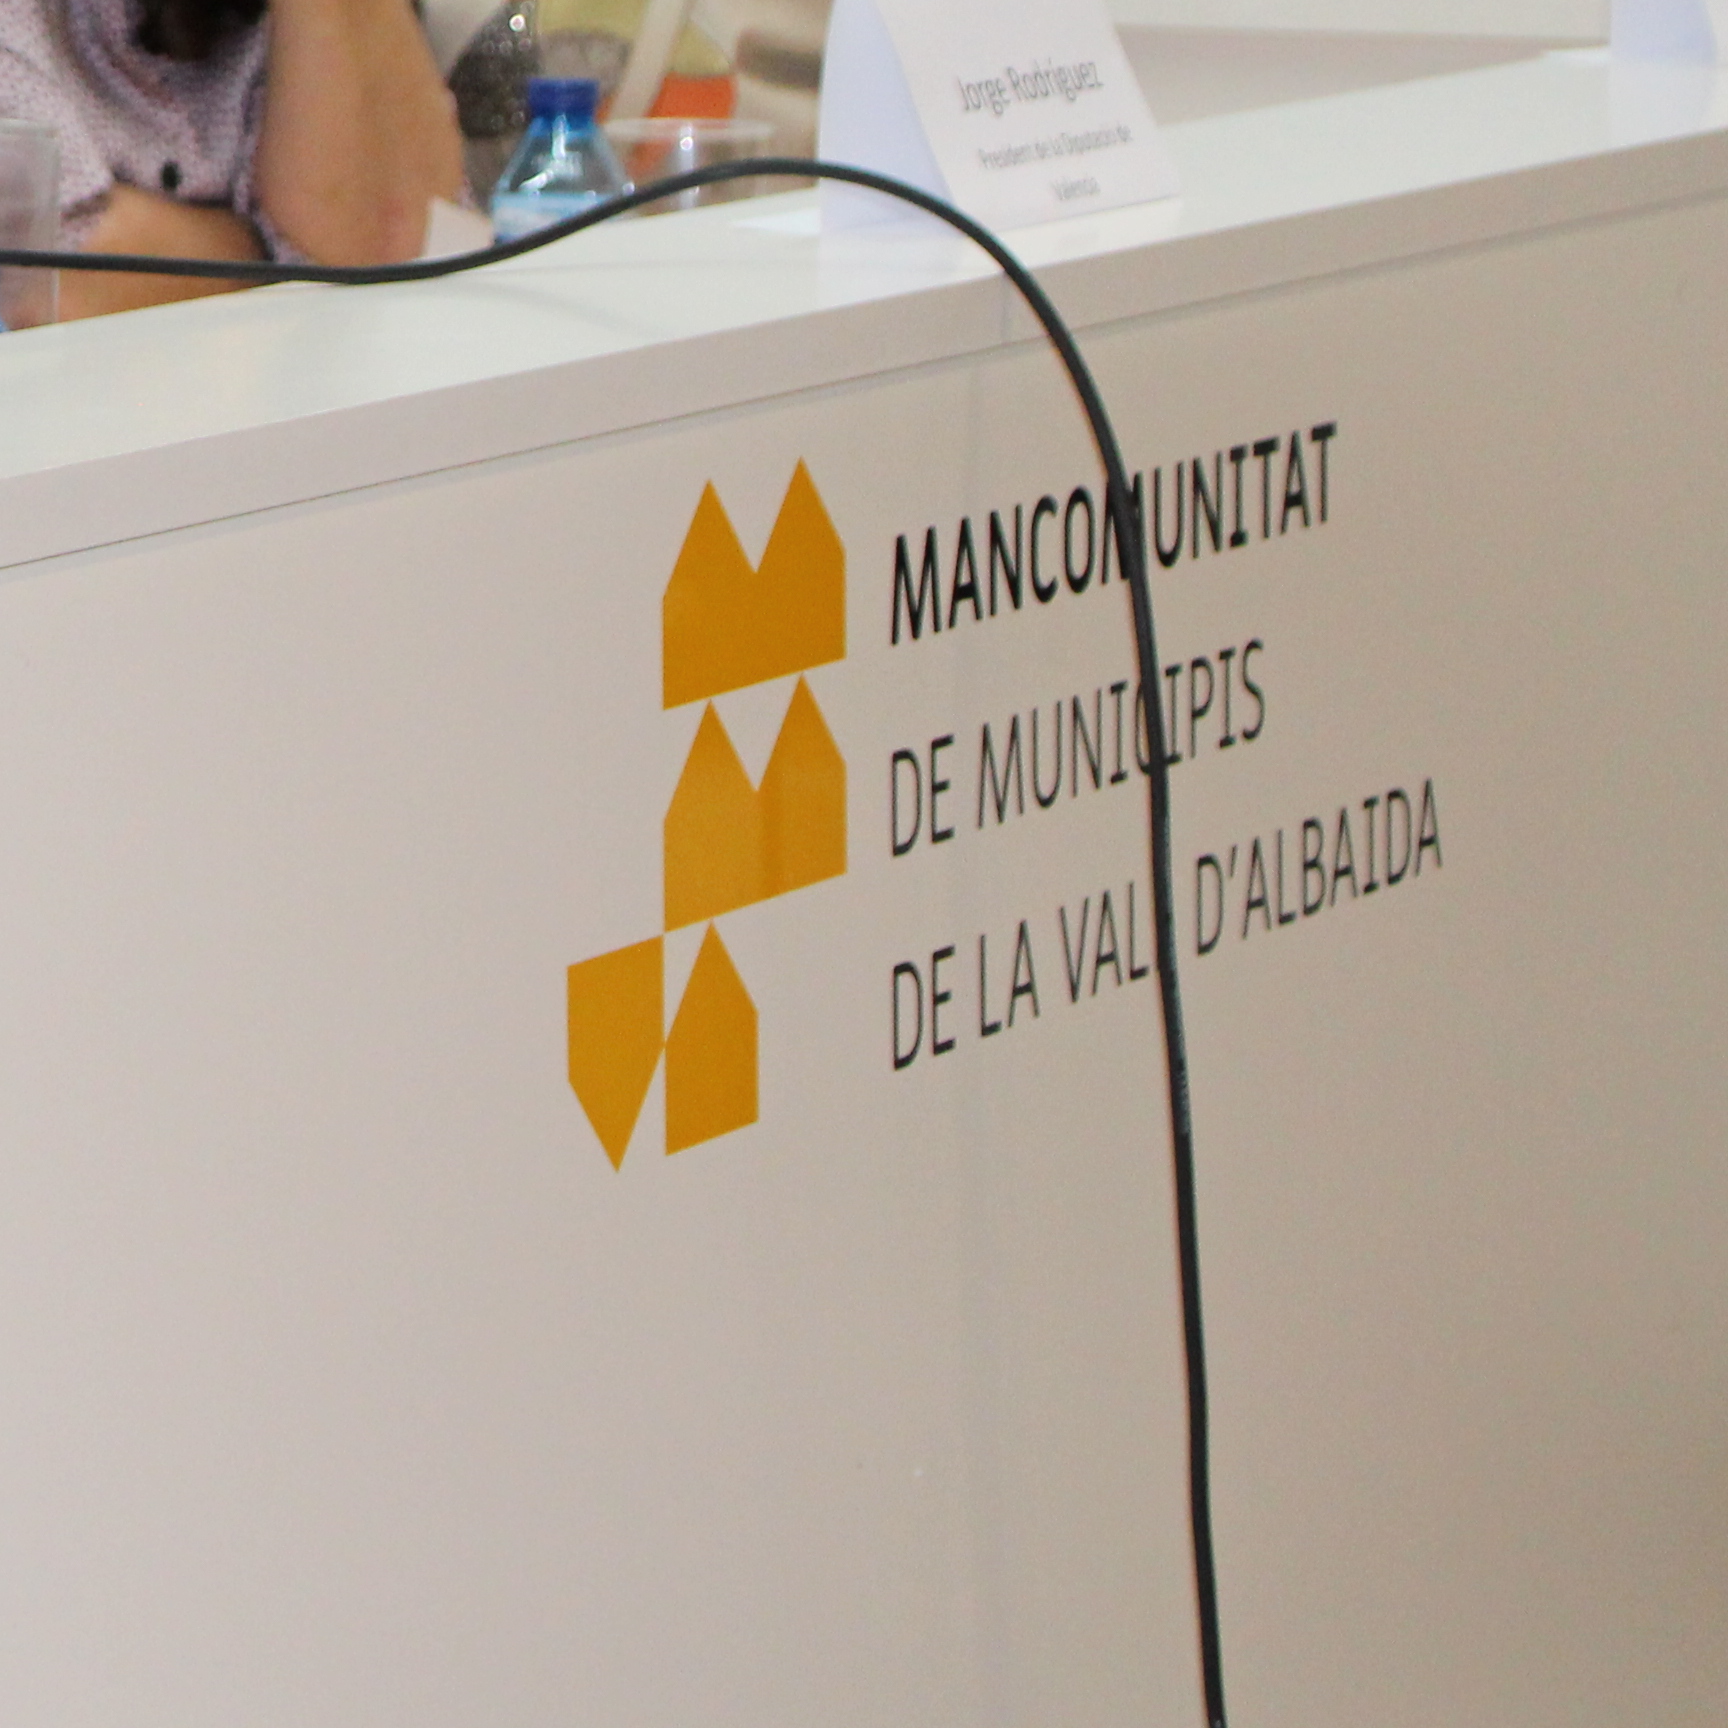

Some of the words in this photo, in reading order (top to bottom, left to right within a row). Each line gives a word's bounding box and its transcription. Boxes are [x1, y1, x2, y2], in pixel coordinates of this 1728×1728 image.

[957, 75, 1010, 116] Jorge
[891, 734, 955, 858] DE
[892, 945, 956, 1071] DE
[979, 918, 1040, 1038] LA
[1059, 872, 1174, 1005] VAL
[1194, 777, 1443, 956] D'ALBAIDA
